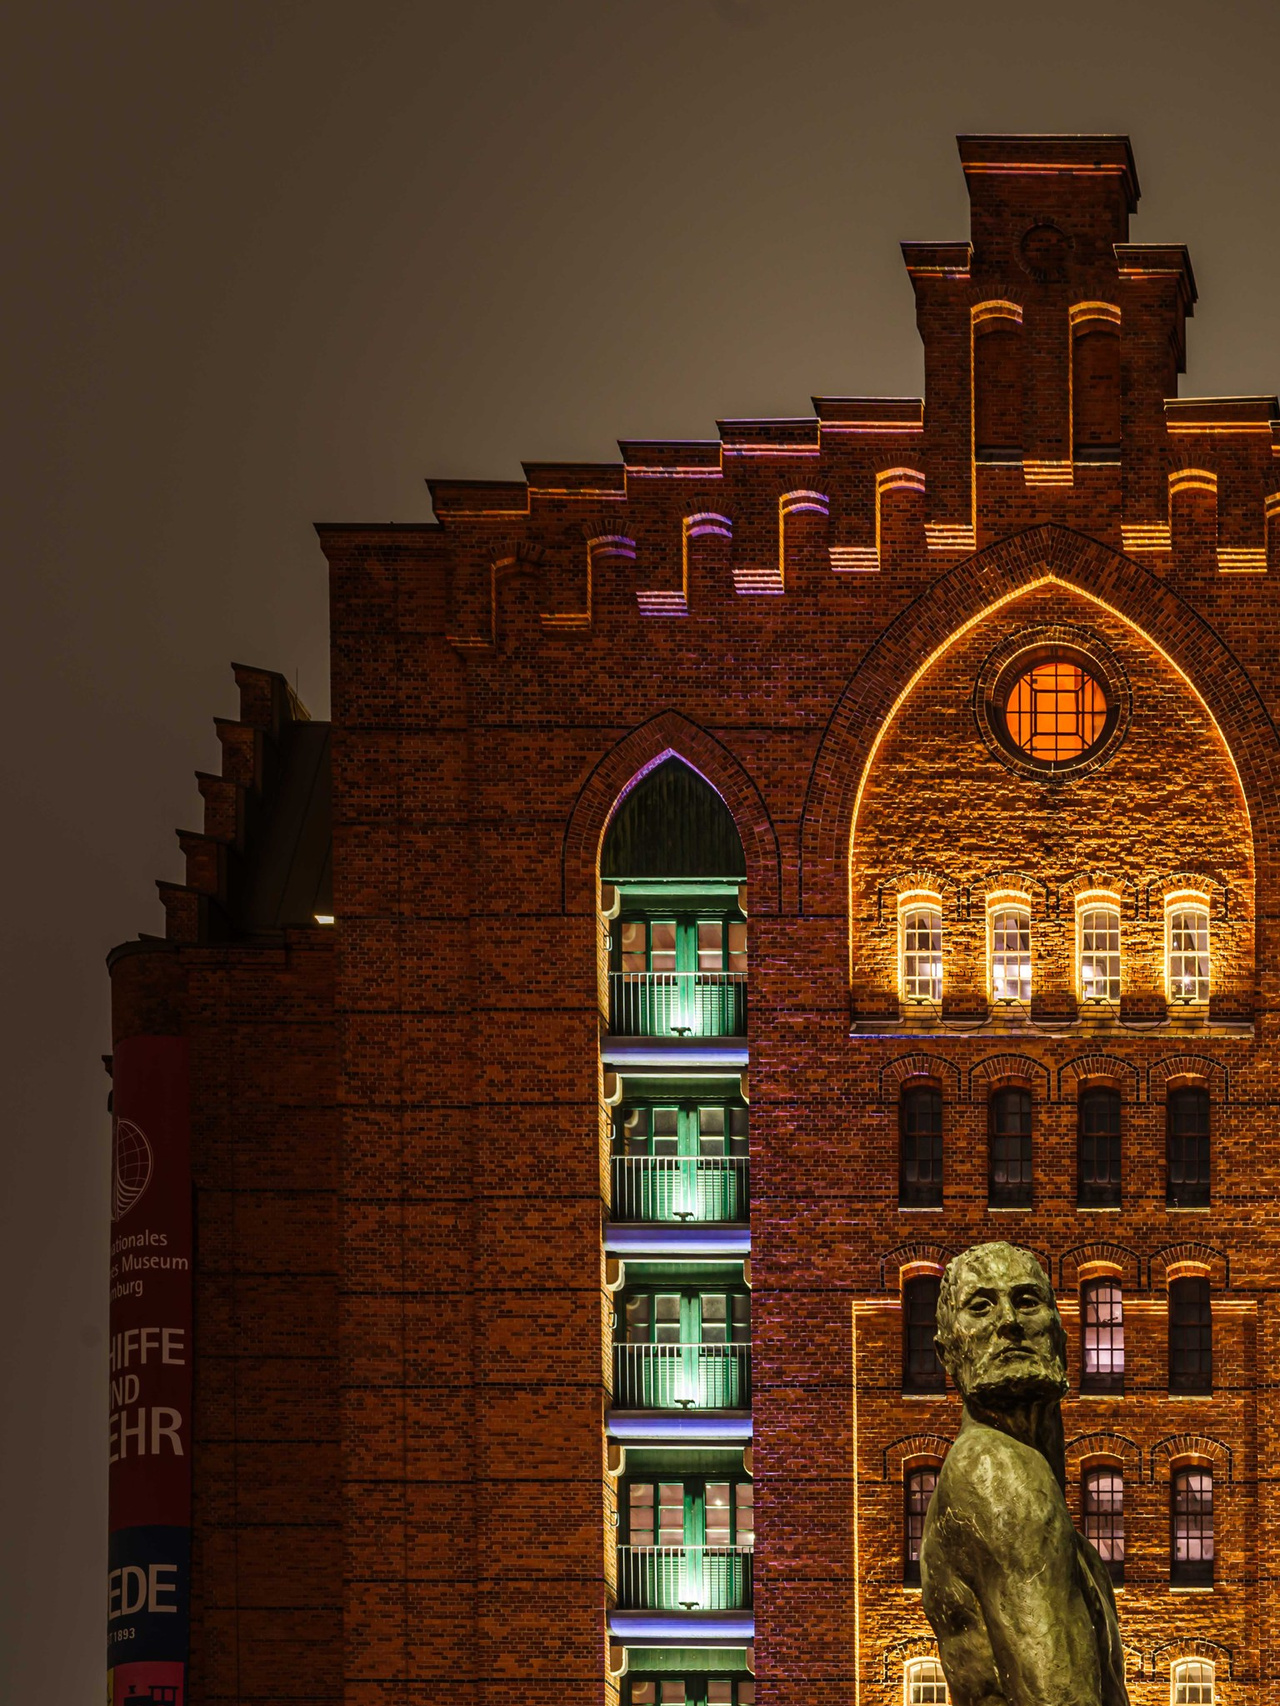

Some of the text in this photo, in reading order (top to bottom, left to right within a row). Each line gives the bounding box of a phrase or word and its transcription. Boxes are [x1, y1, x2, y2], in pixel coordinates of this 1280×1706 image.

[121, 1253, 189, 1273] Museum
[110, 1374, 141, 1411] ND
[108, 1563, 178, 1622] EDE
[113, 1627, 136, 1643] 1893
